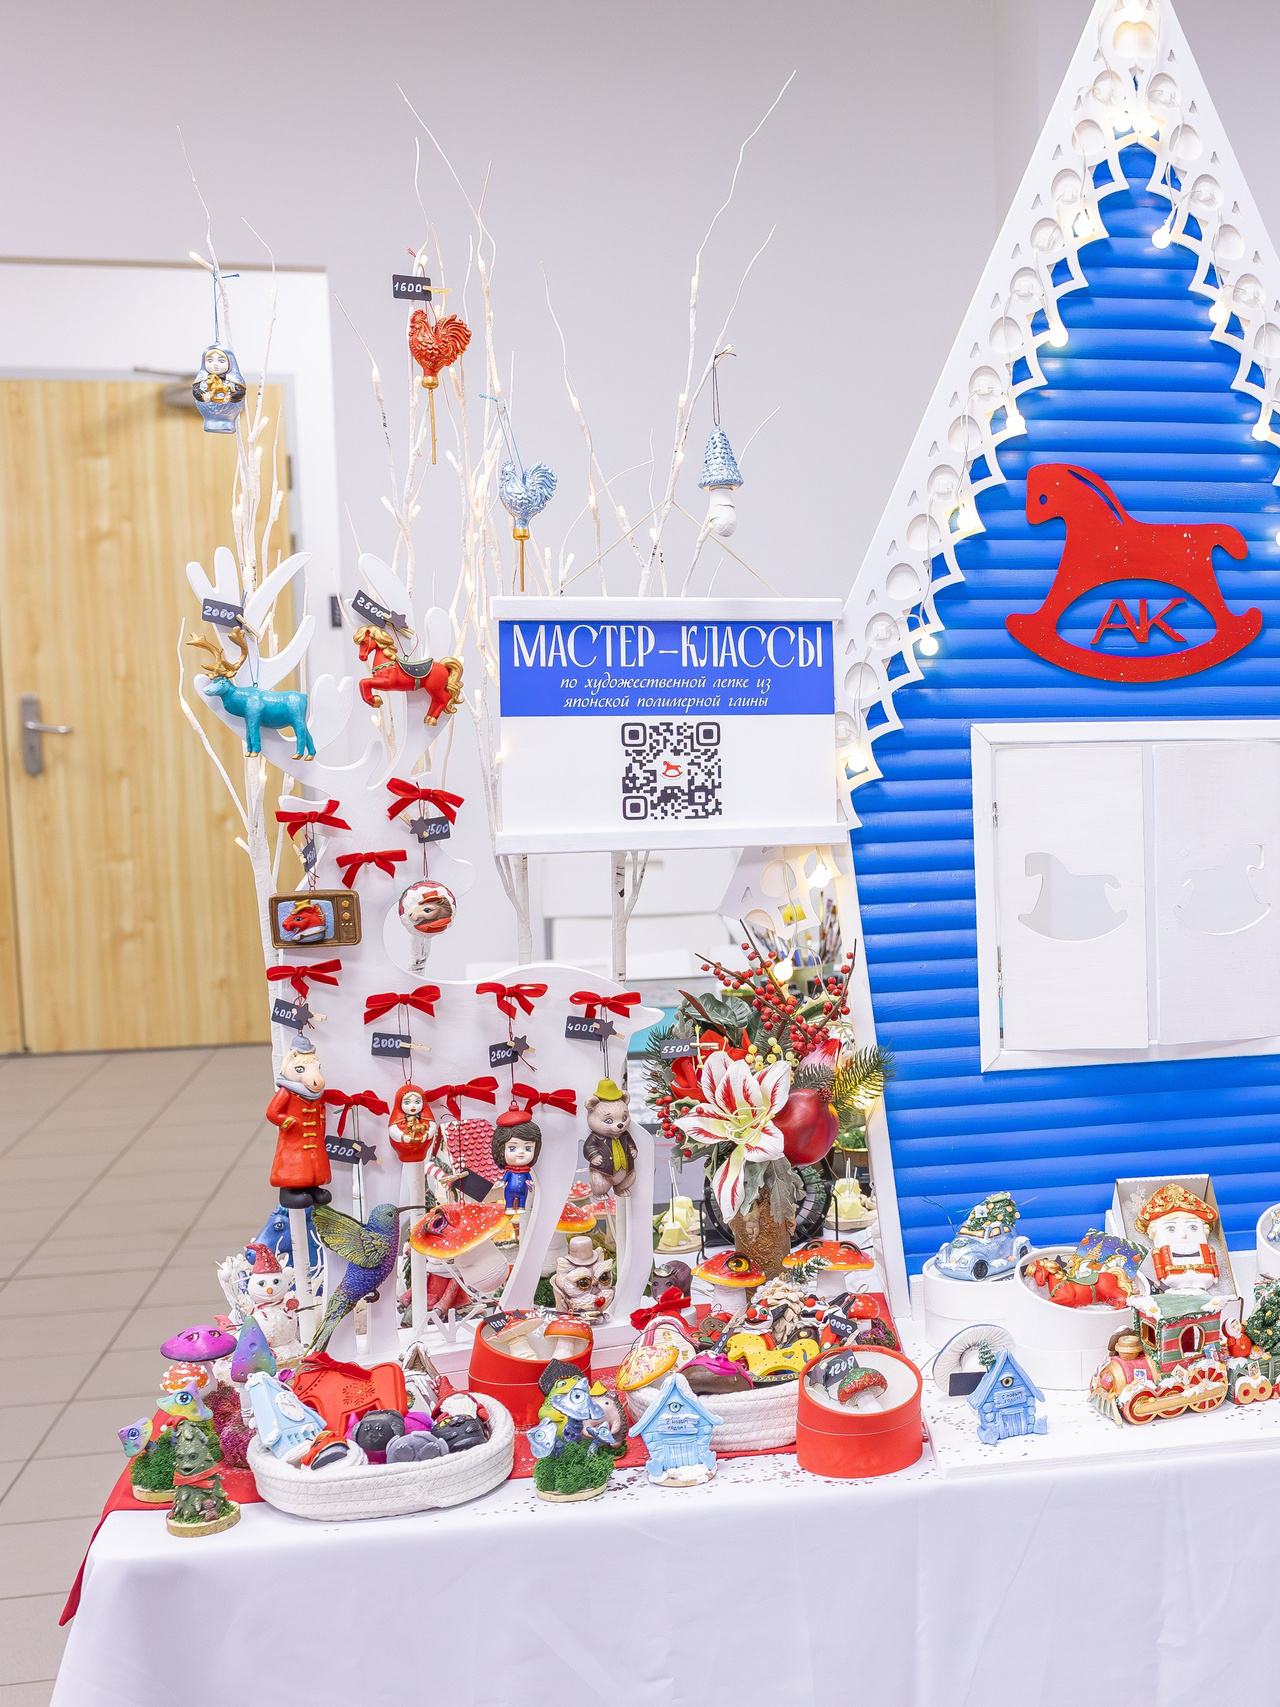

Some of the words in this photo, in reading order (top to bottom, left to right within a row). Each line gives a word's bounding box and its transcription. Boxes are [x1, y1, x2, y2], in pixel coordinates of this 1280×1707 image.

[393, 281, 422, 293] 1600
[203, 605, 235, 621] 2000
[356, 596, 384, 619] 2500
[512, 623, 823, 668] МАСТЕР-КЛАССЫ
[560, 678, 577, 689] по
[584, 671, 706, 695] художественной
[712, 677, 749, 689] лепке
[756, 677, 772, 694] из
[563, 695, 630, 708] японской
[637, 695, 721, 713] полимерной
[728, 696, 768, 707] глины
[372, 1036, 402, 1049] 2000
[661, 1044, 691, 1054] 5500
[490, 1047, 514, 1062] 2500
[325, 1143, 354, 1157] 2500
[829, 1355, 855, 1377] 1200
